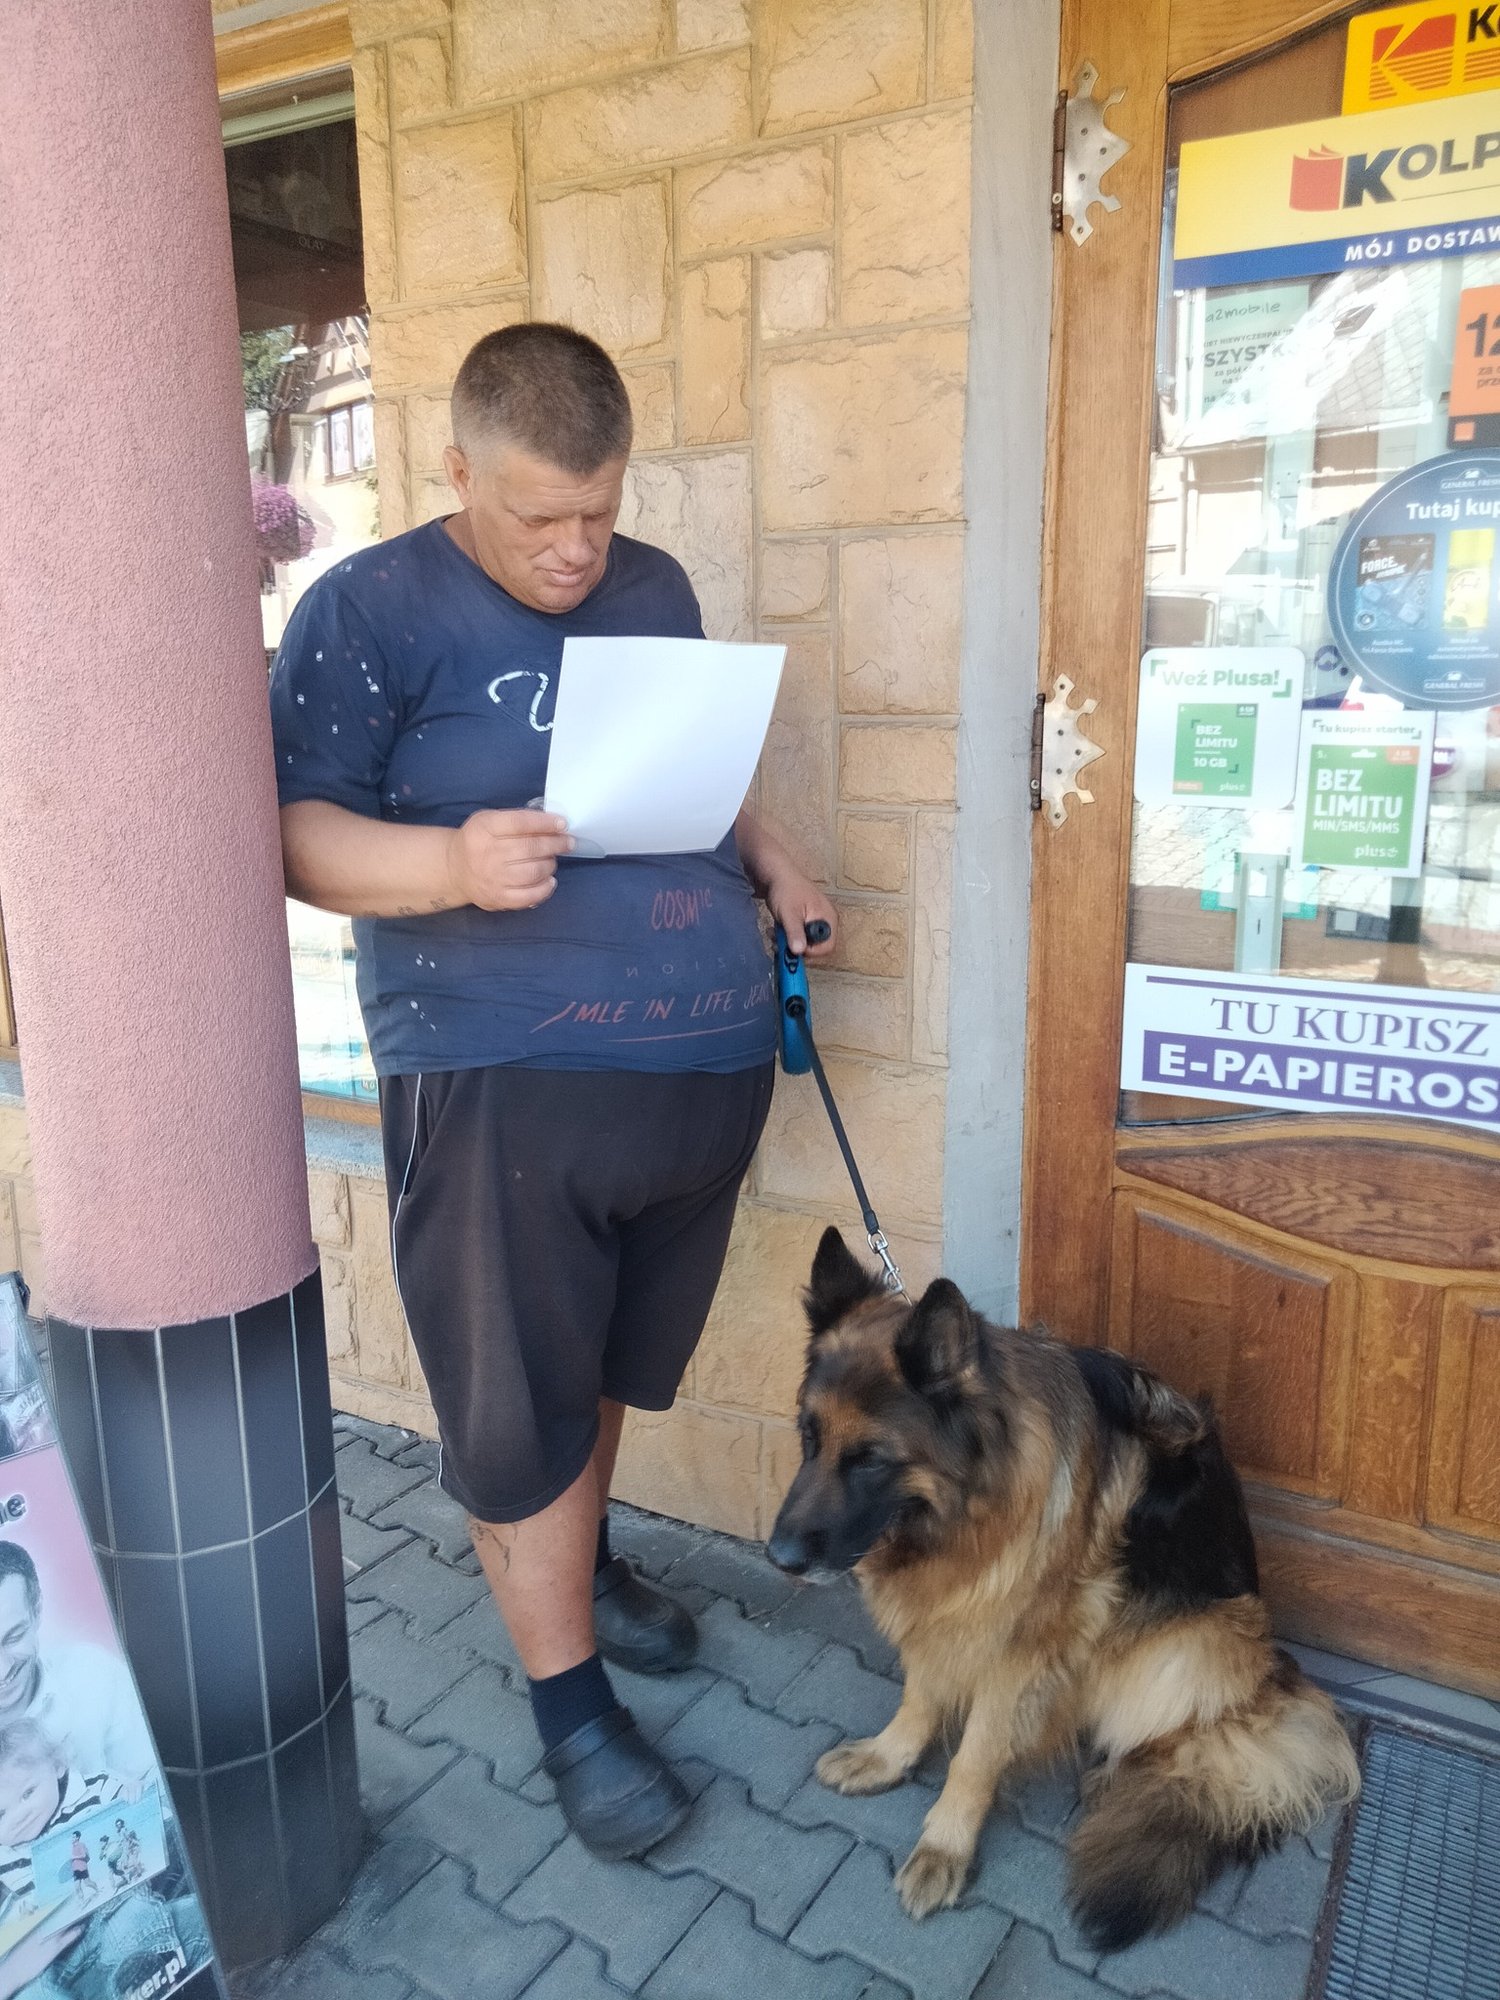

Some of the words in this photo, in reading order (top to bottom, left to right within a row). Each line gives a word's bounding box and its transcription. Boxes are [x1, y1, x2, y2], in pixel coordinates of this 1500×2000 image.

[1467, 4, 1500, 43] K
[1342, 131, 1500, 209] KOLP
[1344, 238, 1393, 262] MÓJ
[1406, 499, 1461, 521] Tutaj
[1162, 669, 1209, 686] Weź
[1213, 668, 1280, 686] Plusa!
[1196, 725, 1223, 735] BEZ
[1195, 737, 1238, 748] LIMITU
[1193, 758, 1208, 767] 10
[1316, 768, 1363, 792] BEZ
[1314, 793, 1403, 819] LIMITU
[1313, 819, 1400, 834] MIN/SMS/MMS
[1355, 844, 1387, 858] plus
[652, 887, 713, 931] COSMIC
[690, 988, 737, 1018] LIFE
[1211, 998, 1280, 1034] TU
[1293, 1006, 1489, 1057] KUPISZ
[1159, 1043, 1499, 1114] E-PAPIEROS
